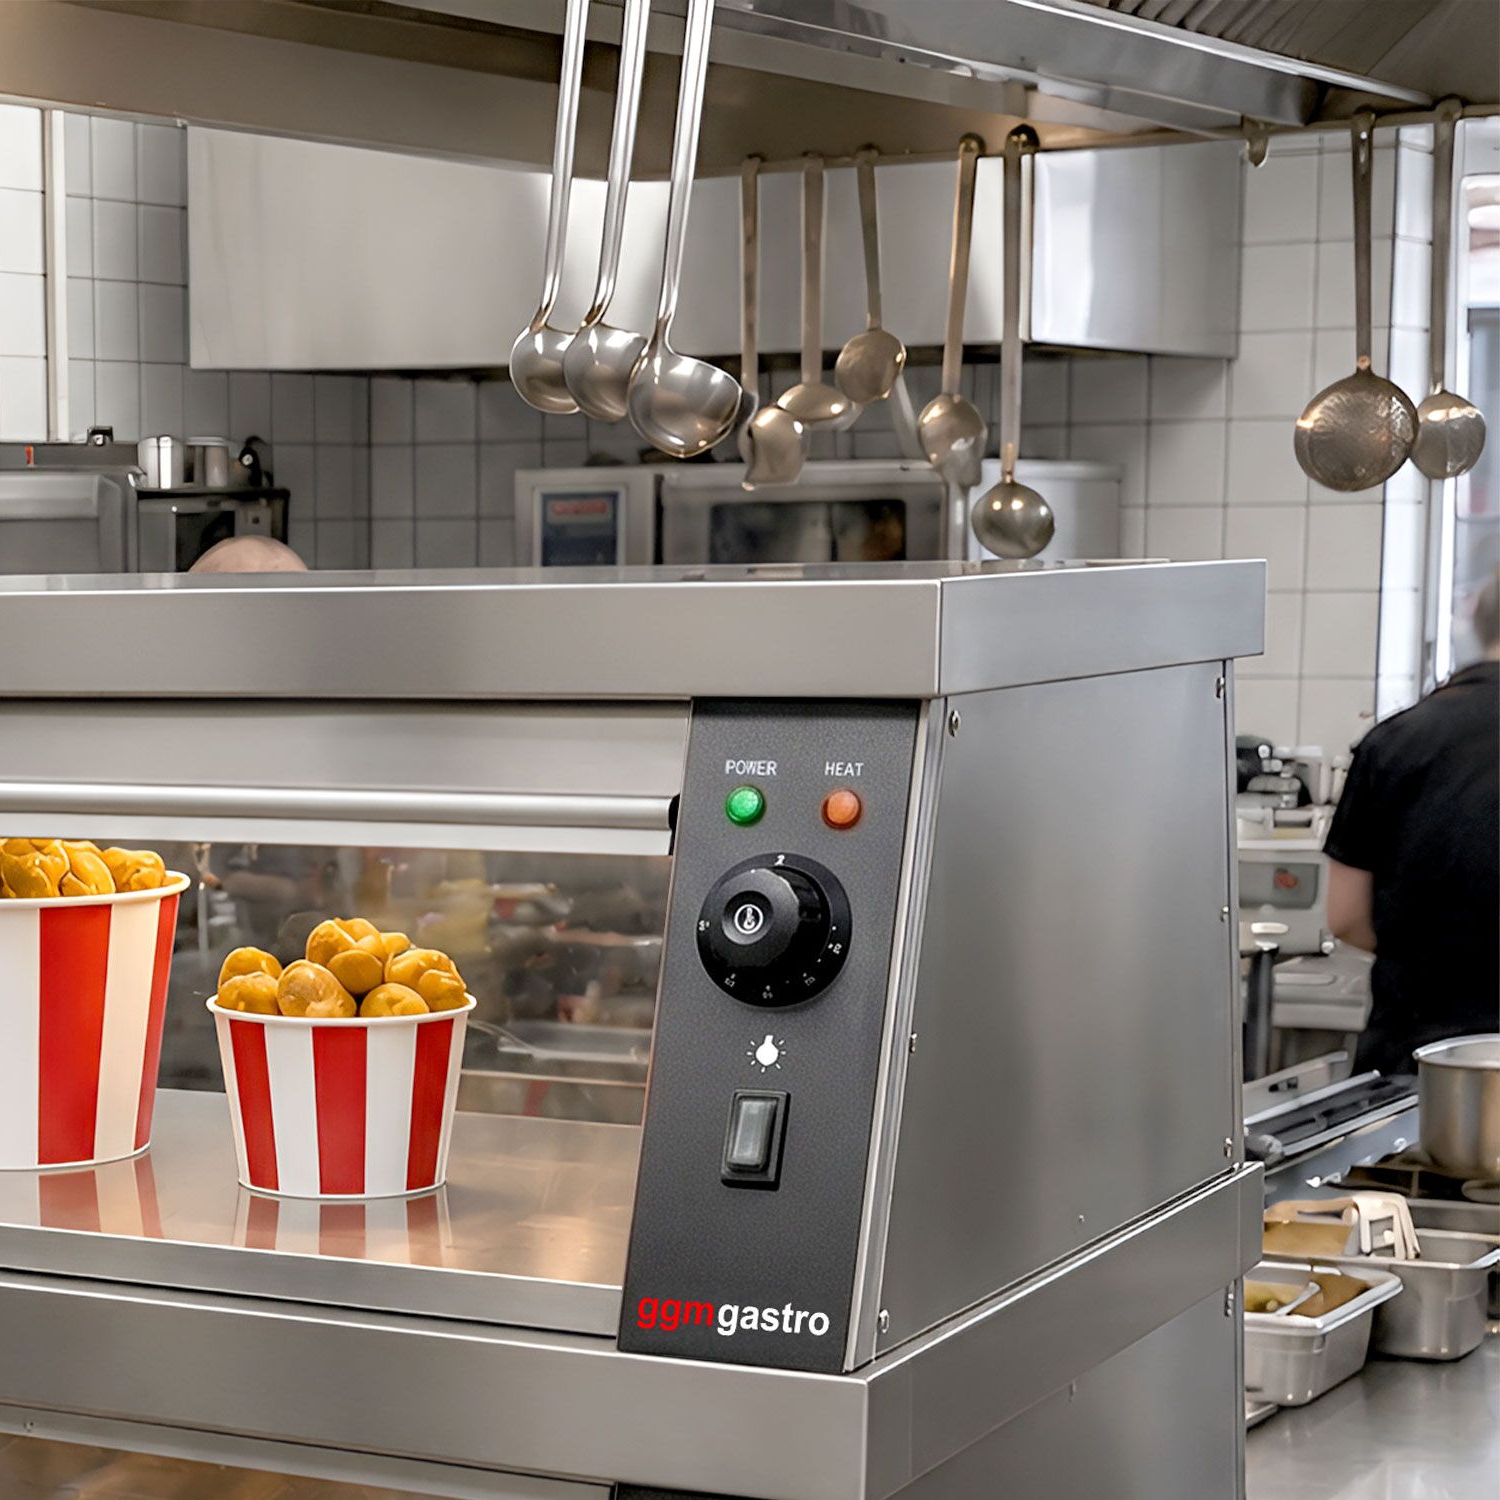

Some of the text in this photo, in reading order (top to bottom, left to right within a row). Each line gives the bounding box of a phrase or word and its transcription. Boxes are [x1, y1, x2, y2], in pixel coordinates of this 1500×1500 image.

[725, 759, 864, 776] POWER HEAT
[636, 1297, 830, 1336] ggmgastro
